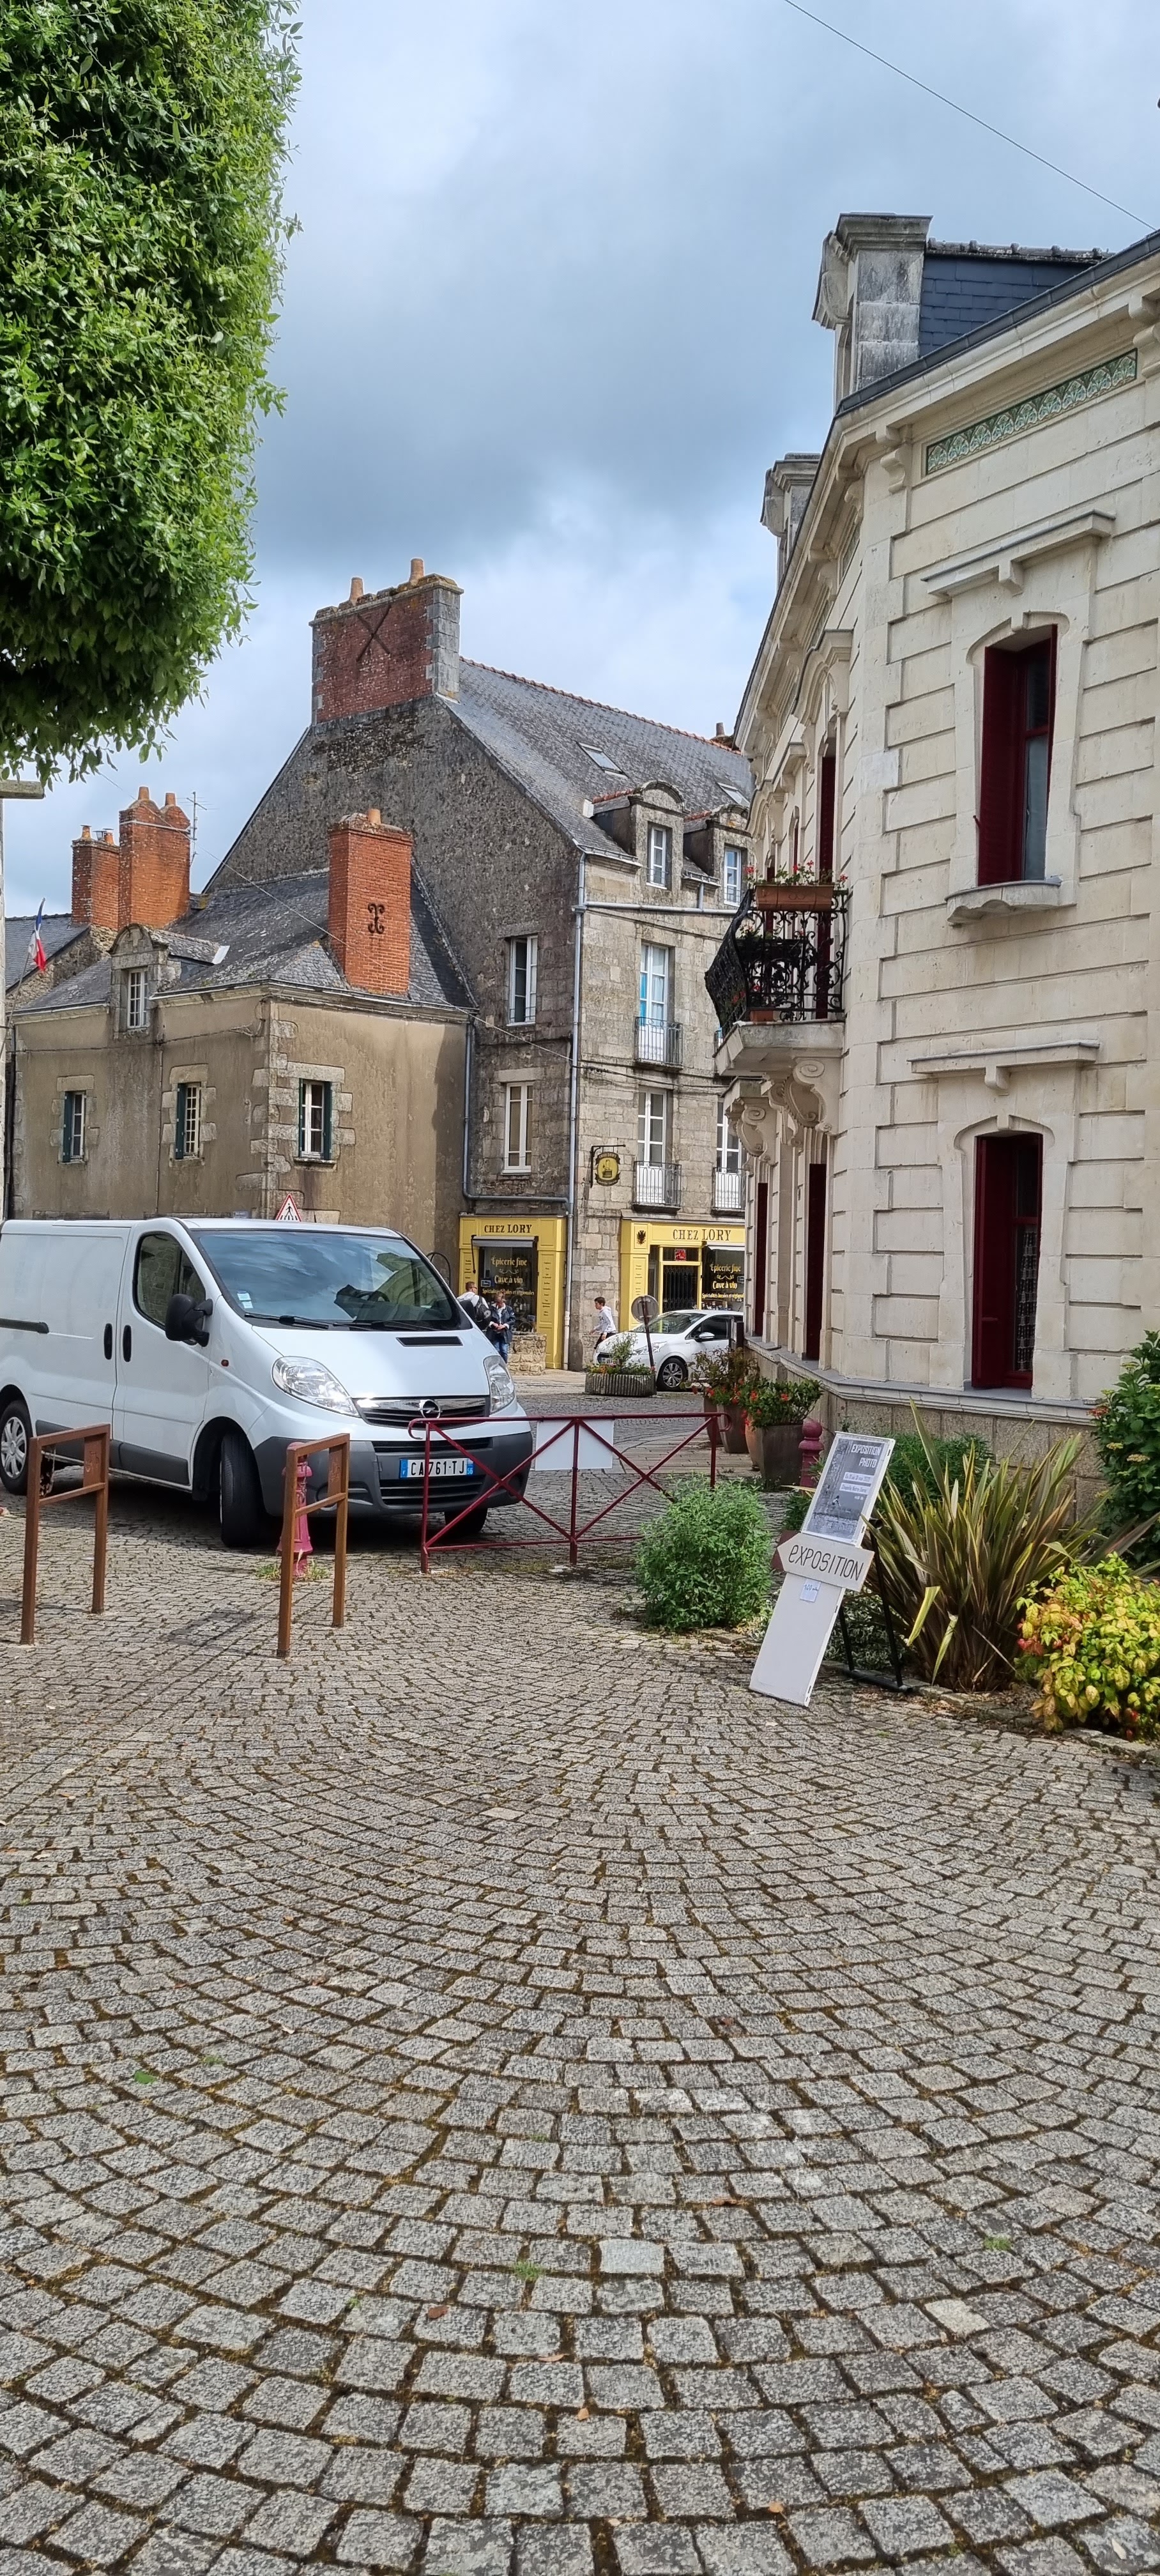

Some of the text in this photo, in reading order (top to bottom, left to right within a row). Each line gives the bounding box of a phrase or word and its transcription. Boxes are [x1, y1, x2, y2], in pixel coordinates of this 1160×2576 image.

[484, 1224, 532, 1233] CHEZ LORY
[673, 1229, 731, 1241] CHEZ LORY
[491, 1256, 528, 1267] Épicerie fine
[494, 1275, 508, 1284] Cave
[514, 1276, 523, 1284] vin
[712, 1281, 725, 1289] Cave
[851, 1444, 881, 1456] EXPOSITION
[859, 1457, 878, 1468] PHOTO
